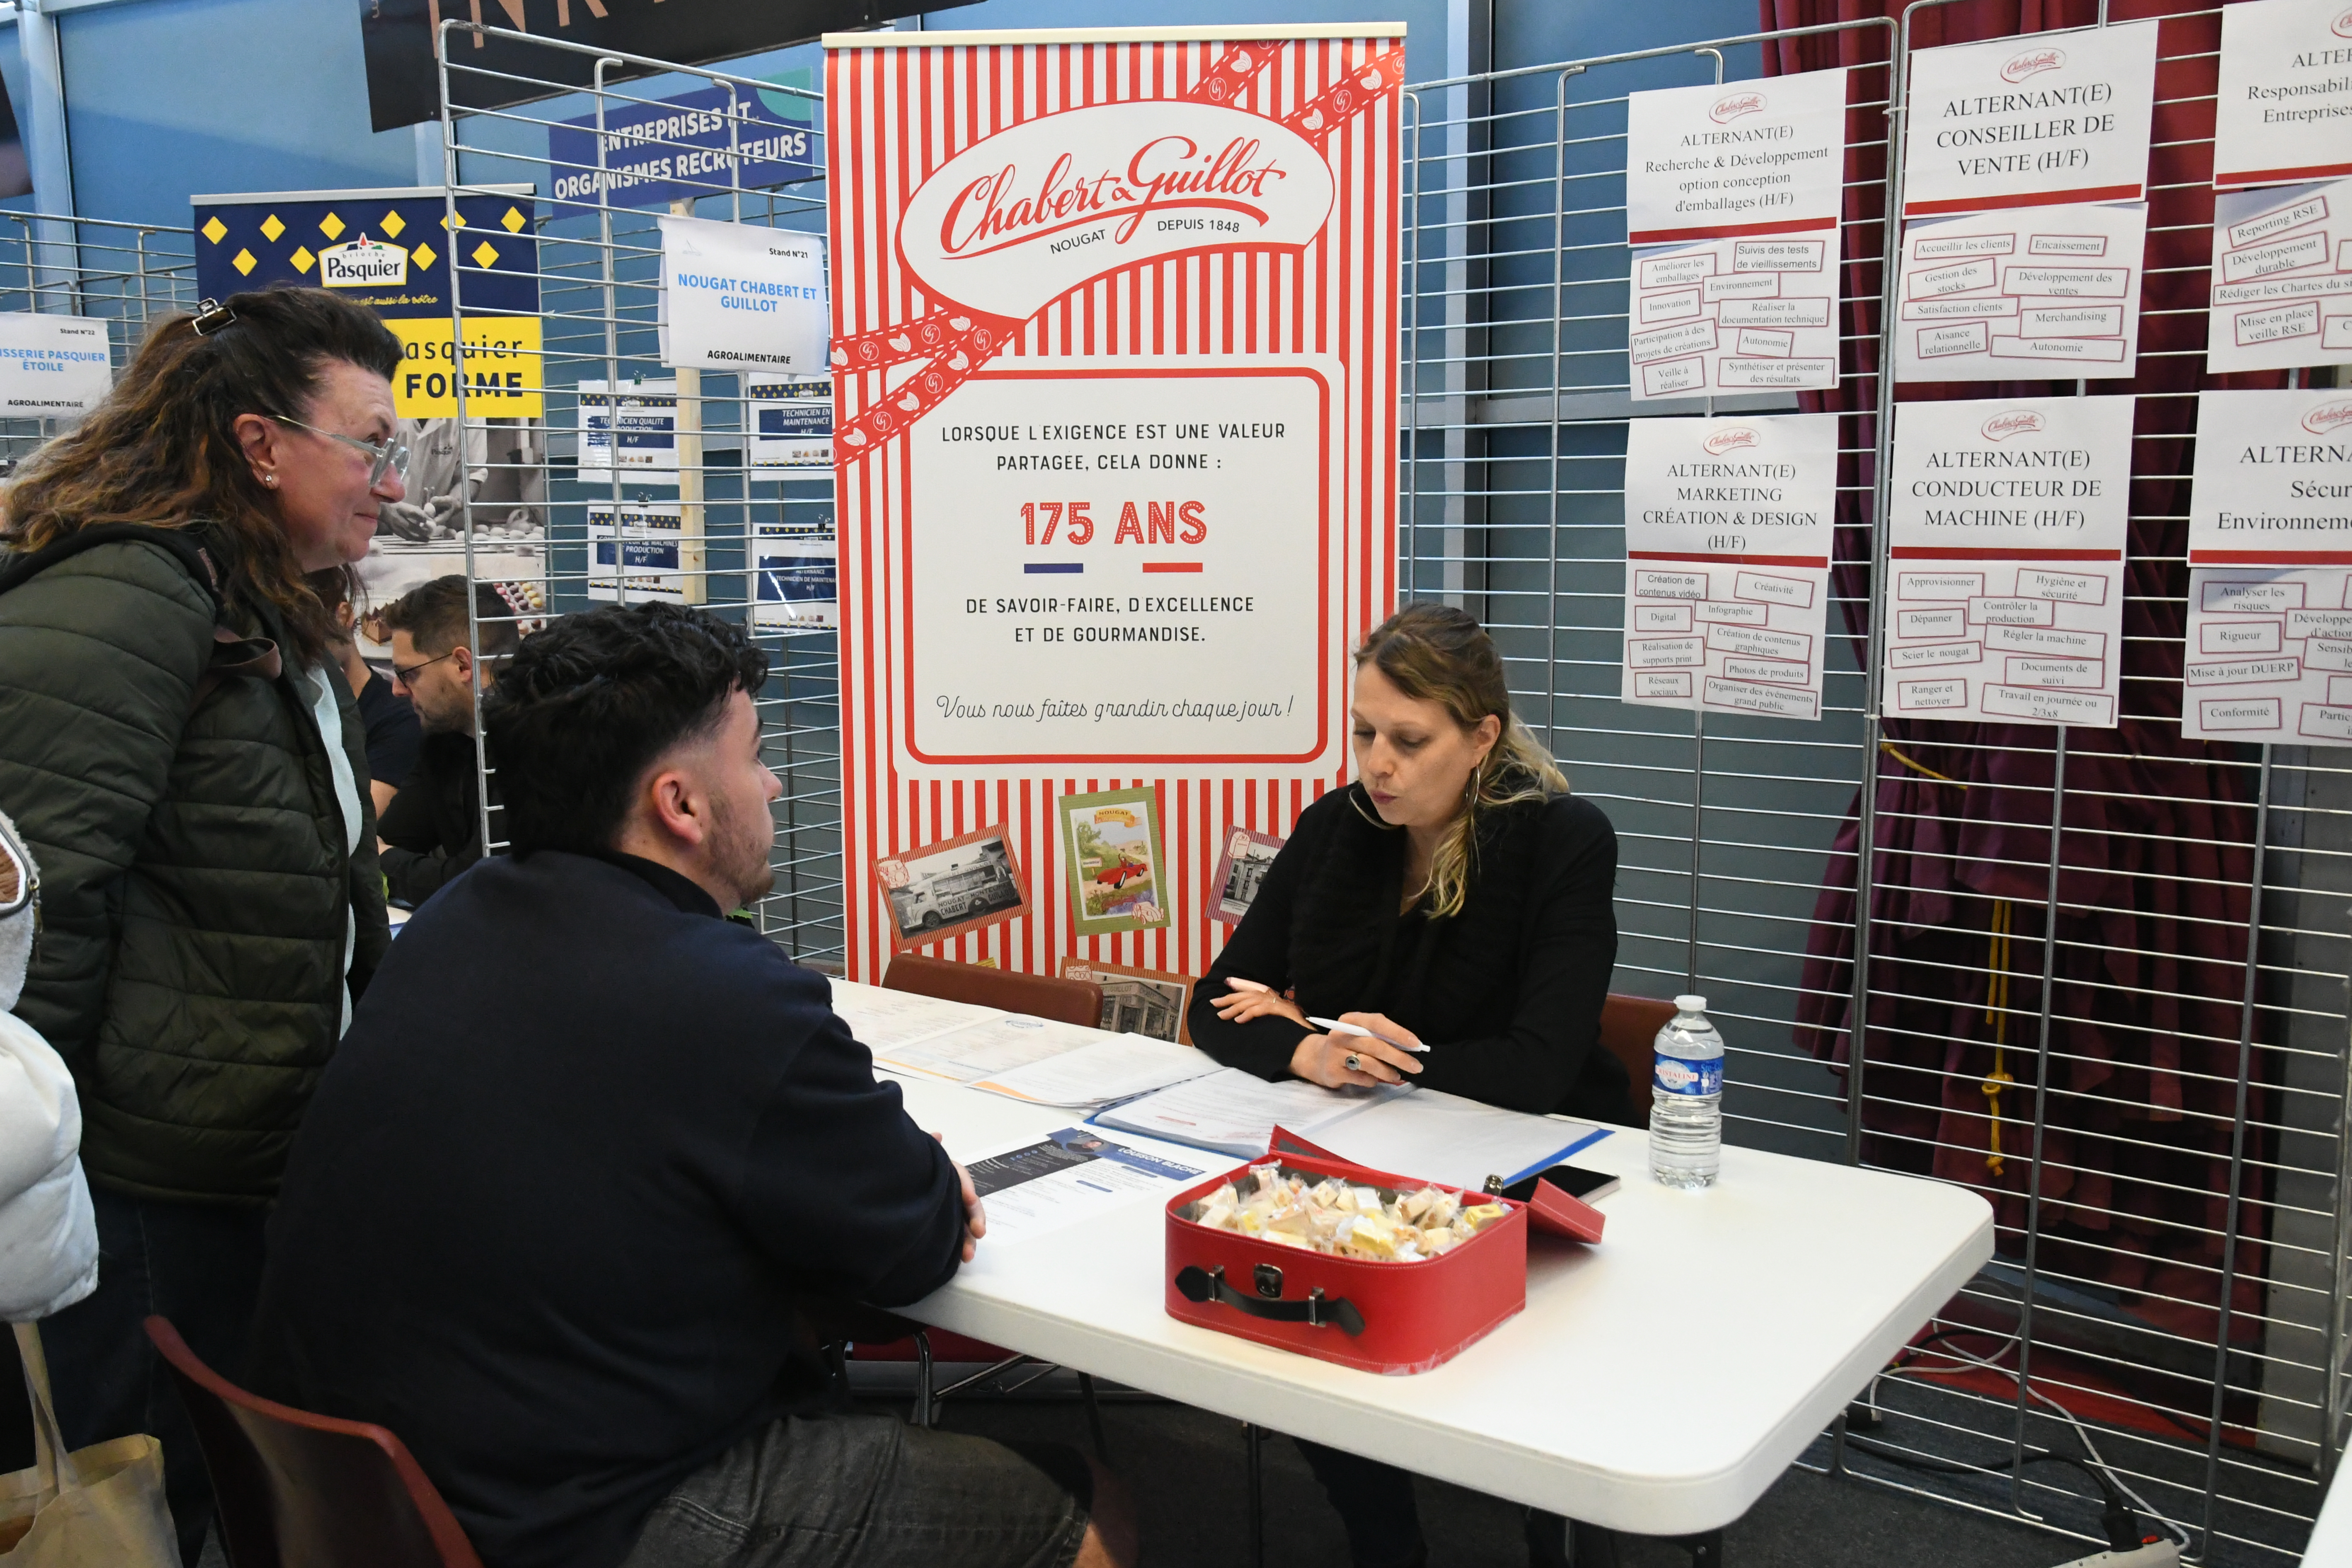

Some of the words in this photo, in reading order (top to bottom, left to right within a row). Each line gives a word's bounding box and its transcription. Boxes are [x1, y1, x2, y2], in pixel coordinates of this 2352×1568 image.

[1943, 83, 2112, 118] ALTERNANT(E)
[1681, 126, 1793, 147] ALTERNANT(E)
[1936, 119, 2076, 148] CONSEILLER
[2083, 114, 2115, 134] DE
[676, 132, 806, 177] RECRTEURS
[1646, 160, 1710, 173] Recherche
[1714, 157, 1725, 168] &
[1731, 147, 1828, 167] Développement
[1957, 154, 2031, 176] VENTE
[2038, 148, 2088, 173] (H/F)
[1679, 180, 1718, 191] option
[1723, 173, 1791, 189] conception
[940, 152, 1121, 254] Chabert
[1115, 135, 1286, 245] Guillot
[1676, 196, 1755, 212] d'emballages
[1759, 192, 1793, 208] (H/F)
[1157, 219, 1203, 232] DEPUIS
[1209, 219, 1240, 233] 1848
[2238, 213, 2289, 238] Reporting
[2293, 204, 2319, 220] RSE
[1050, 229, 1107, 254] NOUGAT
[1919, 242, 1963, 253] Accueillir
[1965, 241, 1978, 250] les
[1981, 240, 2010, 249] clients
[2035, 240, 2100, 250] Encaissement
[769, 248, 790, 256] Stand
[792, 250, 808, 259] N°21
[1738, 245, 1765, 254] Suivis
[1768, 246, 1784, 254] des
[1787, 245, 1809, 254] tests
[2232, 240, 2317, 265] Développement
[328, 258, 400, 281] Pasquier
[1737, 260, 1748, 269] de
[1751, 259, 1816, 269] vieillissements
[2255, 259, 2295, 275] durable
[678, 274, 737, 290] NOUGAT
[740, 281, 798, 297] CHABERT
[803, 288, 817, 299] ET
[1710, 279, 1772, 291] Environnement
[721, 296, 777, 312] GUILLOT
[1650, 299, 1691, 311] Innovation
[1918, 304, 1971, 314] Satisfaction
[1973, 303, 2002, 312] clients
[2036, 312, 2107, 323] Merchandising
[1743, 336, 1788, 348] Autonomie
[2031, 343, 2083, 352] Autonomie
[48, 351, 105, 362] PASQUIER
[708, 350, 791, 364] AGROALIMENTAIRE
[23, 359, 63, 371] ÉTOILE
[782, 409, 820, 417] TECHNICIEN
[783, 417, 829, 426] MAINTENANCE
[942, 426, 1020, 442] LORSQUE
[1136, 425, 1166, 439] EST
[1176, 424, 1210, 439] UNE
[1219, 423, 1285, 438] VALEUR
[1098, 455, 1141, 469] CELA
[1150, 454, 1208, 469] DONNE
[1926, 450, 2090, 470] ALTERNANT(E)
[1667, 464, 1796, 481] ALTERNANT(E)
[1677, 487, 1782, 501] MARKETING
[1912, 480, 2065, 497] CONDUCTEUR
[2072, 480, 2101, 496] DE
[1021, 502, 1094, 544] 175
[1114, 501, 1207, 544] ANS
[1643, 507, 1728, 525] CRÉATION
[1733, 512, 1746, 525] &
[1751, 512, 1817, 526] DESIGN
[1924, 510, 2027, 526] MACHINE
[2034, 510, 2084, 530] (H/F)
[1708, 534, 1746, 552] (H/F)
[626, 546, 664, 554] PRODUCTION
[1647, 575, 1682, 584] Création
[1685, 577, 1695, 585] de
[1907, 577, 1975, 587] Approvisionner
[1639, 589, 1676, 598] contenus
[1679, 589, 1701, 599] vidéo
[1754, 582, 1794, 594] Créativité
[2221, 587, 2268, 598] Analyser
[2271, 588, 2285, 596] les
[966, 599, 988, 613] DE
[996, 598, 1120, 615] SAVOIR-FAIRE,
[1708, 605, 1753, 616] Infographie
[2234, 603, 2270, 611] risques
[1651, 613, 1677, 623] Digital
[1911, 614, 1952, 624] Dépanner
[1015, 628, 1034, 642] ET
[1044, 628, 1064, 642] DE
[1073, 627, 1205, 642] GOURMANDISE.
[2220, 631, 2261, 642] Rigueur
[1729, 665, 1756, 675] Photos
[1758, 667, 1768, 675] de
[1770, 669, 1803, 678] produits
[2021, 662, 2073, 672] Documents
[2076, 664, 2088, 673] de
[2191, 668, 2215, 677] Mise
[2219, 667, 2224, 676] à
[2226, 667, 2247, 678] jour
[2251, 663, 2294, 674] DUERP
[2042, 676, 2064, 685] suivi
[936, 695, 986, 719] Vous
[993, 702, 1034, 718] nous
[1094, 699, 1168, 722] grandir
[1172, 699, 1238, 721] chaque
[1236, 702, 1282, 722] jour
[2032, 708, 2058, 718] 2/3x8
[2210, 707, 2269, 717] Conformité
[938, 897, 965, 907] NOUGAT
[941, 902, 966, 915] CHABERT
